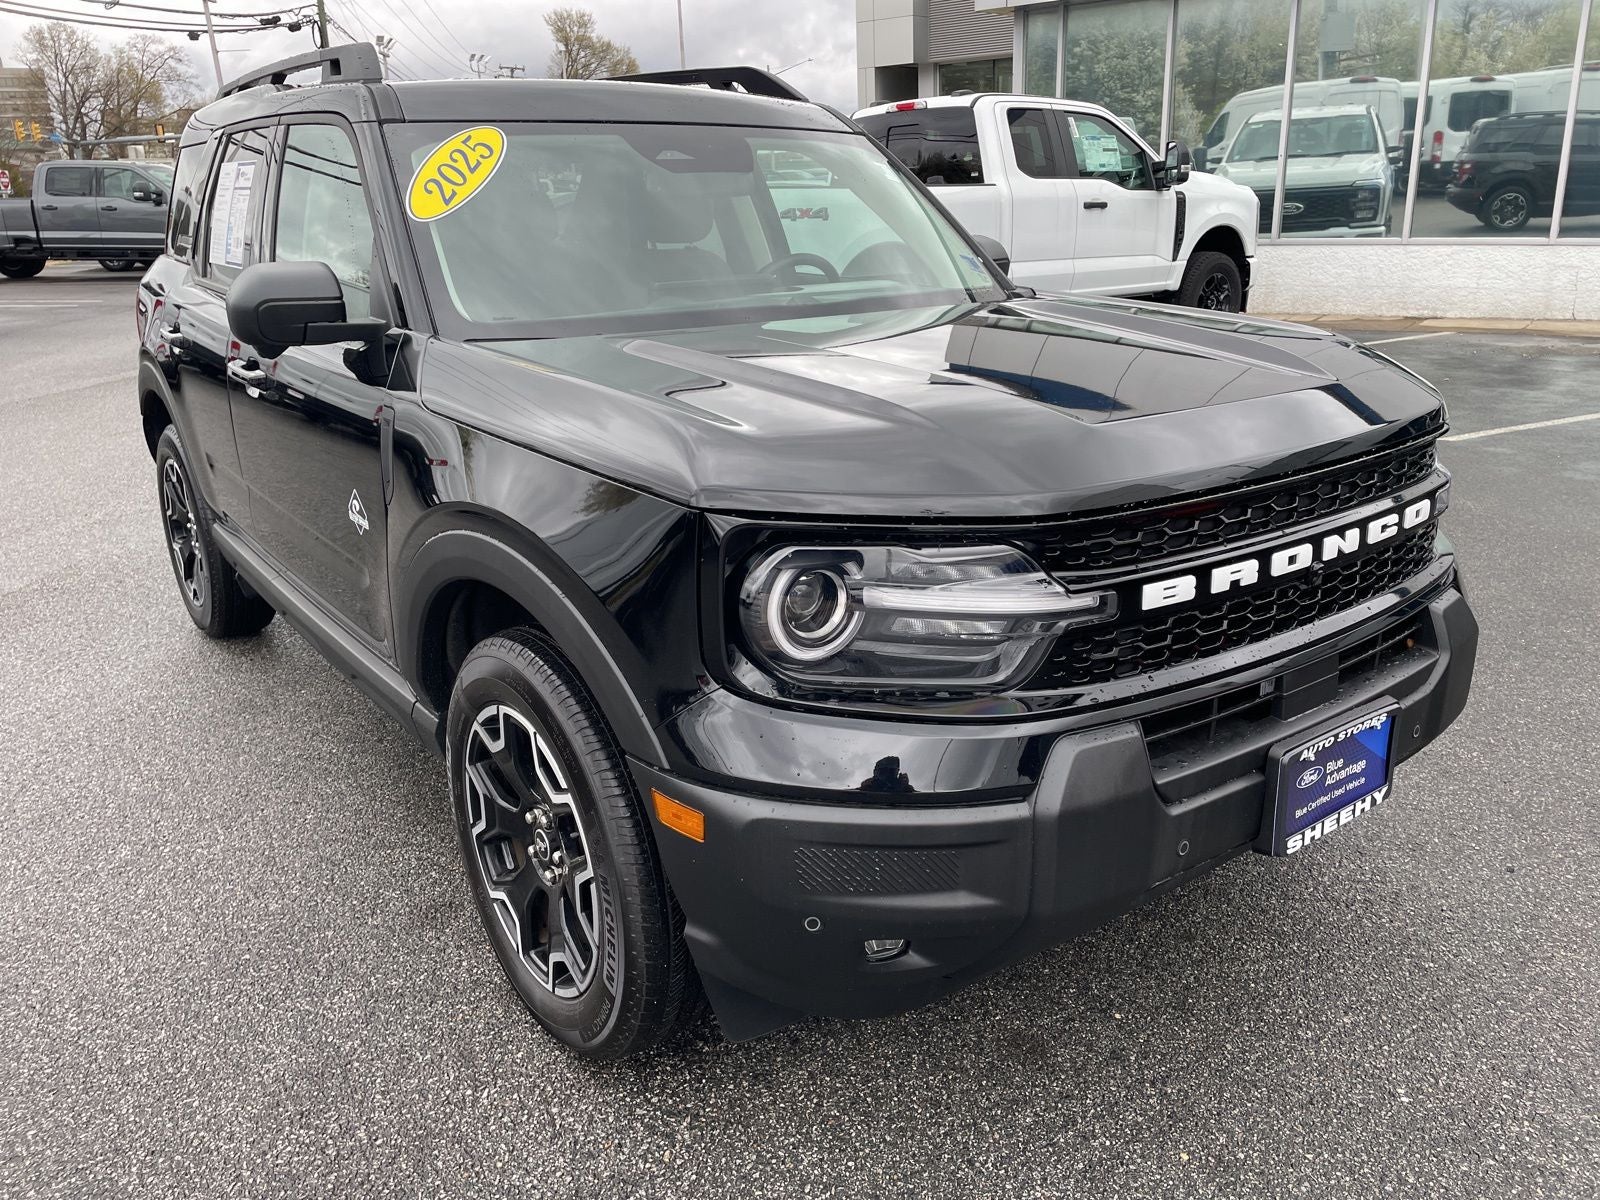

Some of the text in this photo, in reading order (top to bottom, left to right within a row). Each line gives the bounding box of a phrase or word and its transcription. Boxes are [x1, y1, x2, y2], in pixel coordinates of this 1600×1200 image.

[424, 135, 494, 206] 2025
[1142, 499, 1431, 611] BRONCO
[1300, 713, 1388, 761] AUTO STORES
[1299, 768, 1321, 787] Ford
[1325, 759, 1367, 786] Advantage
[1326, 758, 1344, 773] Blue
[1286, 786, 1389, 855] SHEEHY
[1295, 776, 1366, 819] Blue Certified Used Vehicle
[600, 873, 616, 989] MICHELIN
